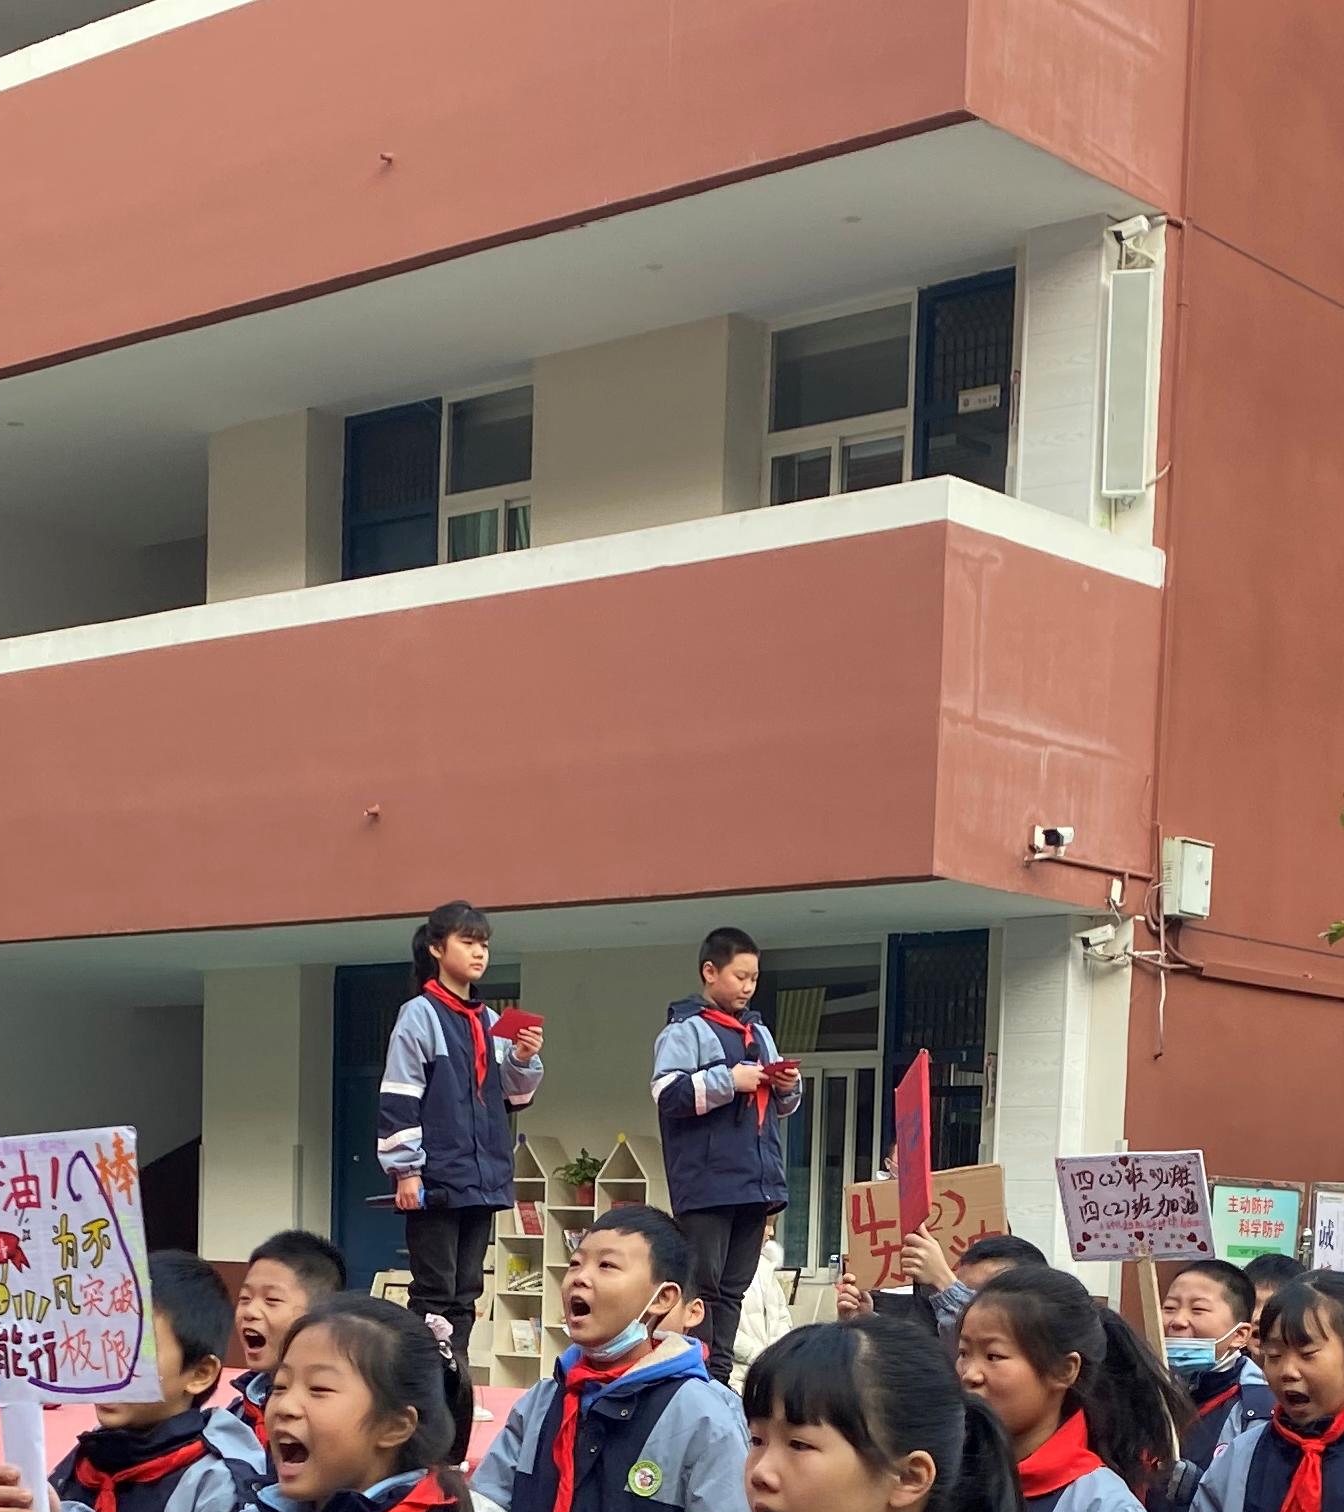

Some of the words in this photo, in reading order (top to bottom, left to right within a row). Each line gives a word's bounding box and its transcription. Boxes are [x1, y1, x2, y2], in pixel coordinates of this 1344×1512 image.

[1227, 1195, 1275, 1216] 主动防护
[1238, 1217, 1286, 1239] 科学防护
